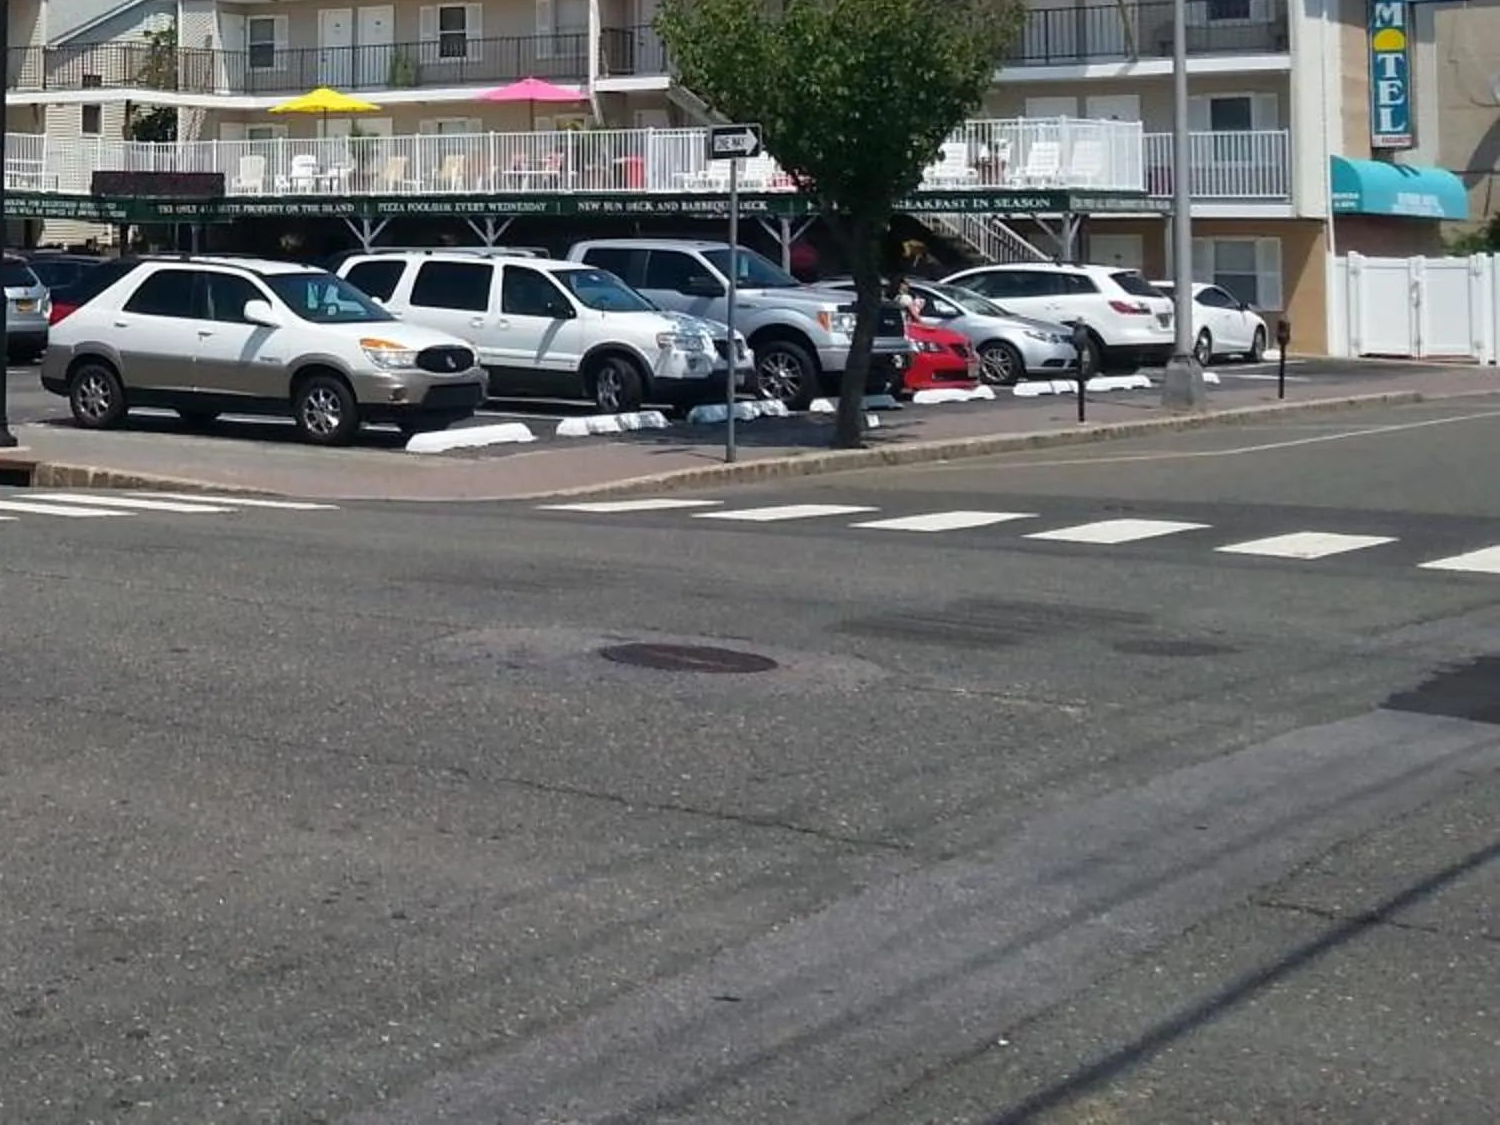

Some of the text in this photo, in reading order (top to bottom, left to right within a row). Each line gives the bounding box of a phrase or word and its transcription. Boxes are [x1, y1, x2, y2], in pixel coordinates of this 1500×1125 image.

[454, 202, 486, 212] EVERY
[488, 202, 547, 212] WEDNESDAY
[577, 201, 600, 211] NEW
[603, 201, 623, 211] SUN
[625, 201, 653, 211] DECK
[656, 201, 679, 211] AND
[681, 201, 734, 214] BARBEQU
[973, 198, 989, 208] IN
[994, 197, 1051, 209] SEASON
